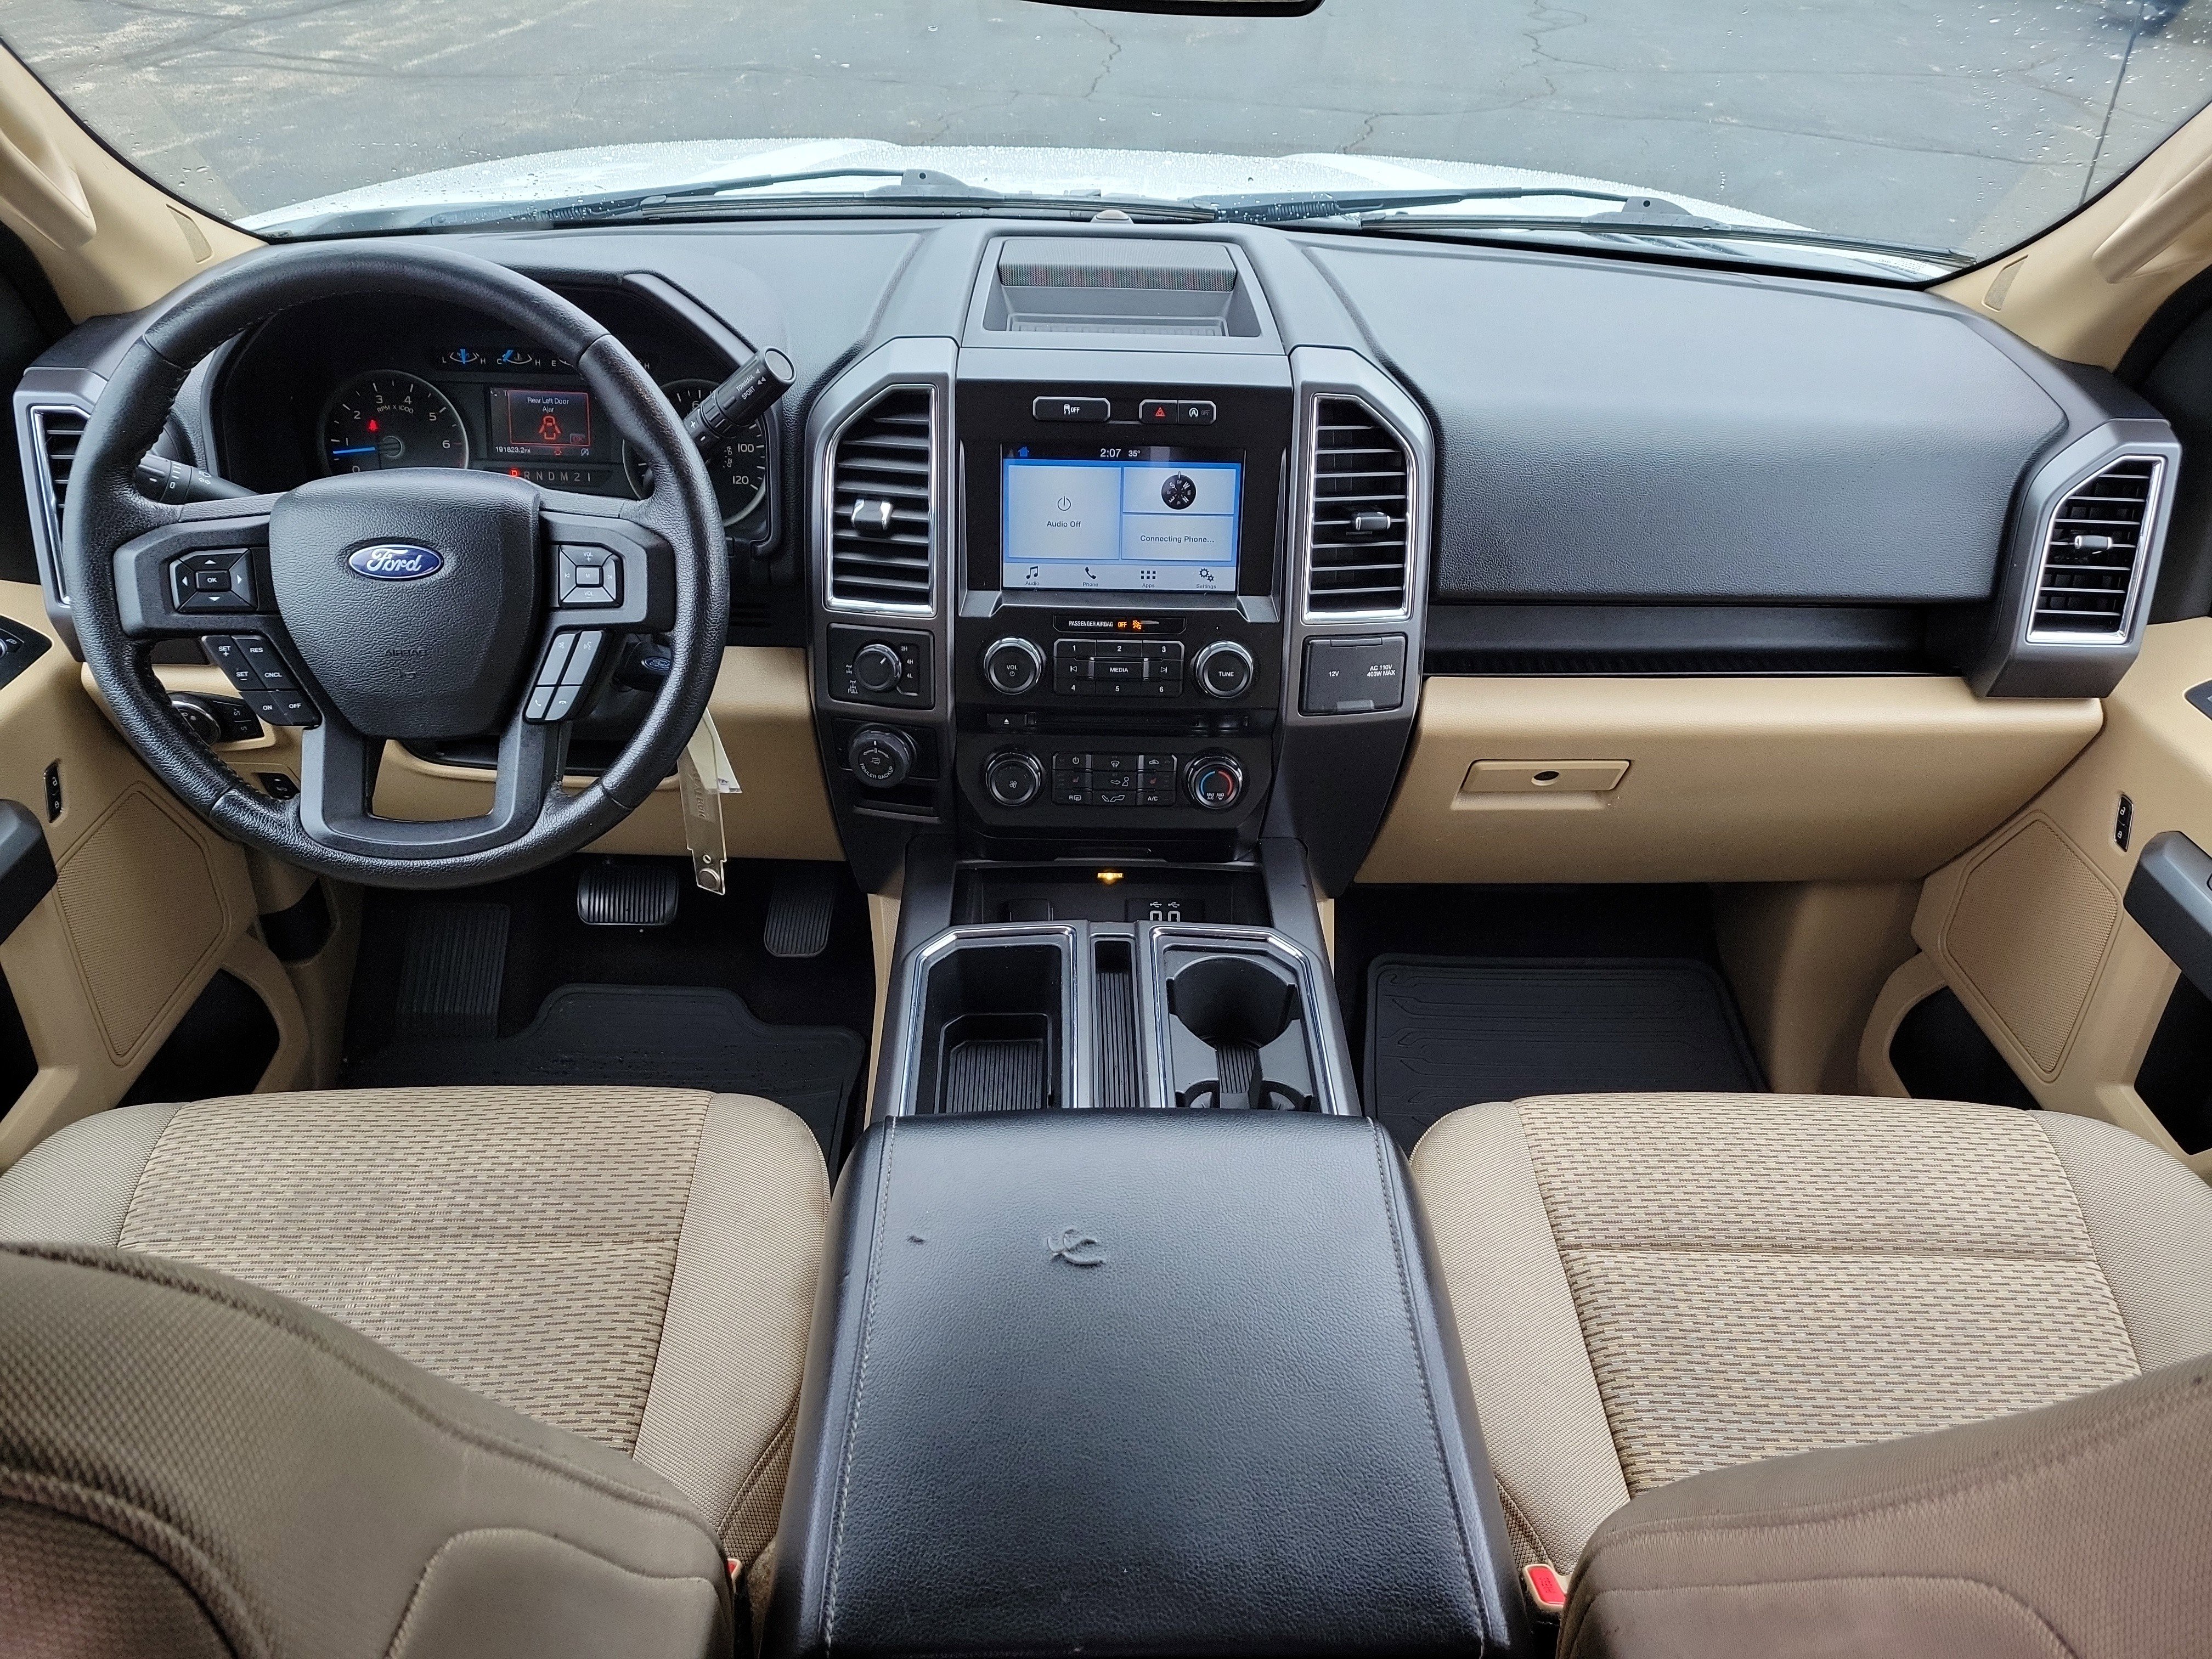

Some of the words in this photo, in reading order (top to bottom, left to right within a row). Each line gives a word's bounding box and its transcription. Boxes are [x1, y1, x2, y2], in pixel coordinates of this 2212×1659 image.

[741, 386, 755, 400] SPORT
[376, 395, 383, 404] 3
[404, 396, 412, 405] 4
[377, 404, 391, 413] RPM
[398, 404, 414, 414] 1000
[542, 405, 555, 414] Ajar
[353, 410, 361, 420] 2
[429, 413, 437, 421] 5
[442, 439, 450, 449] 6
[738, 443, 754, 453] 100
[1100, 448, 1121, 458] 2:07
[524, 471, 531, 479] R
[536, 472, 543, 481] N
[549, 472, 555, 481] D
[560, 472, 568, 481] M
[574, 472, 581, 482] 2
[732, 475, 749, 484] 120
[1182, 481, 1190, 489] W
[1140, 535, 1182, 543] Connecting
[366, 548, 422, 572] Ford
[859, 763, 877, 779] TRAILER
[878, 766, 894, 780] BACKUP
